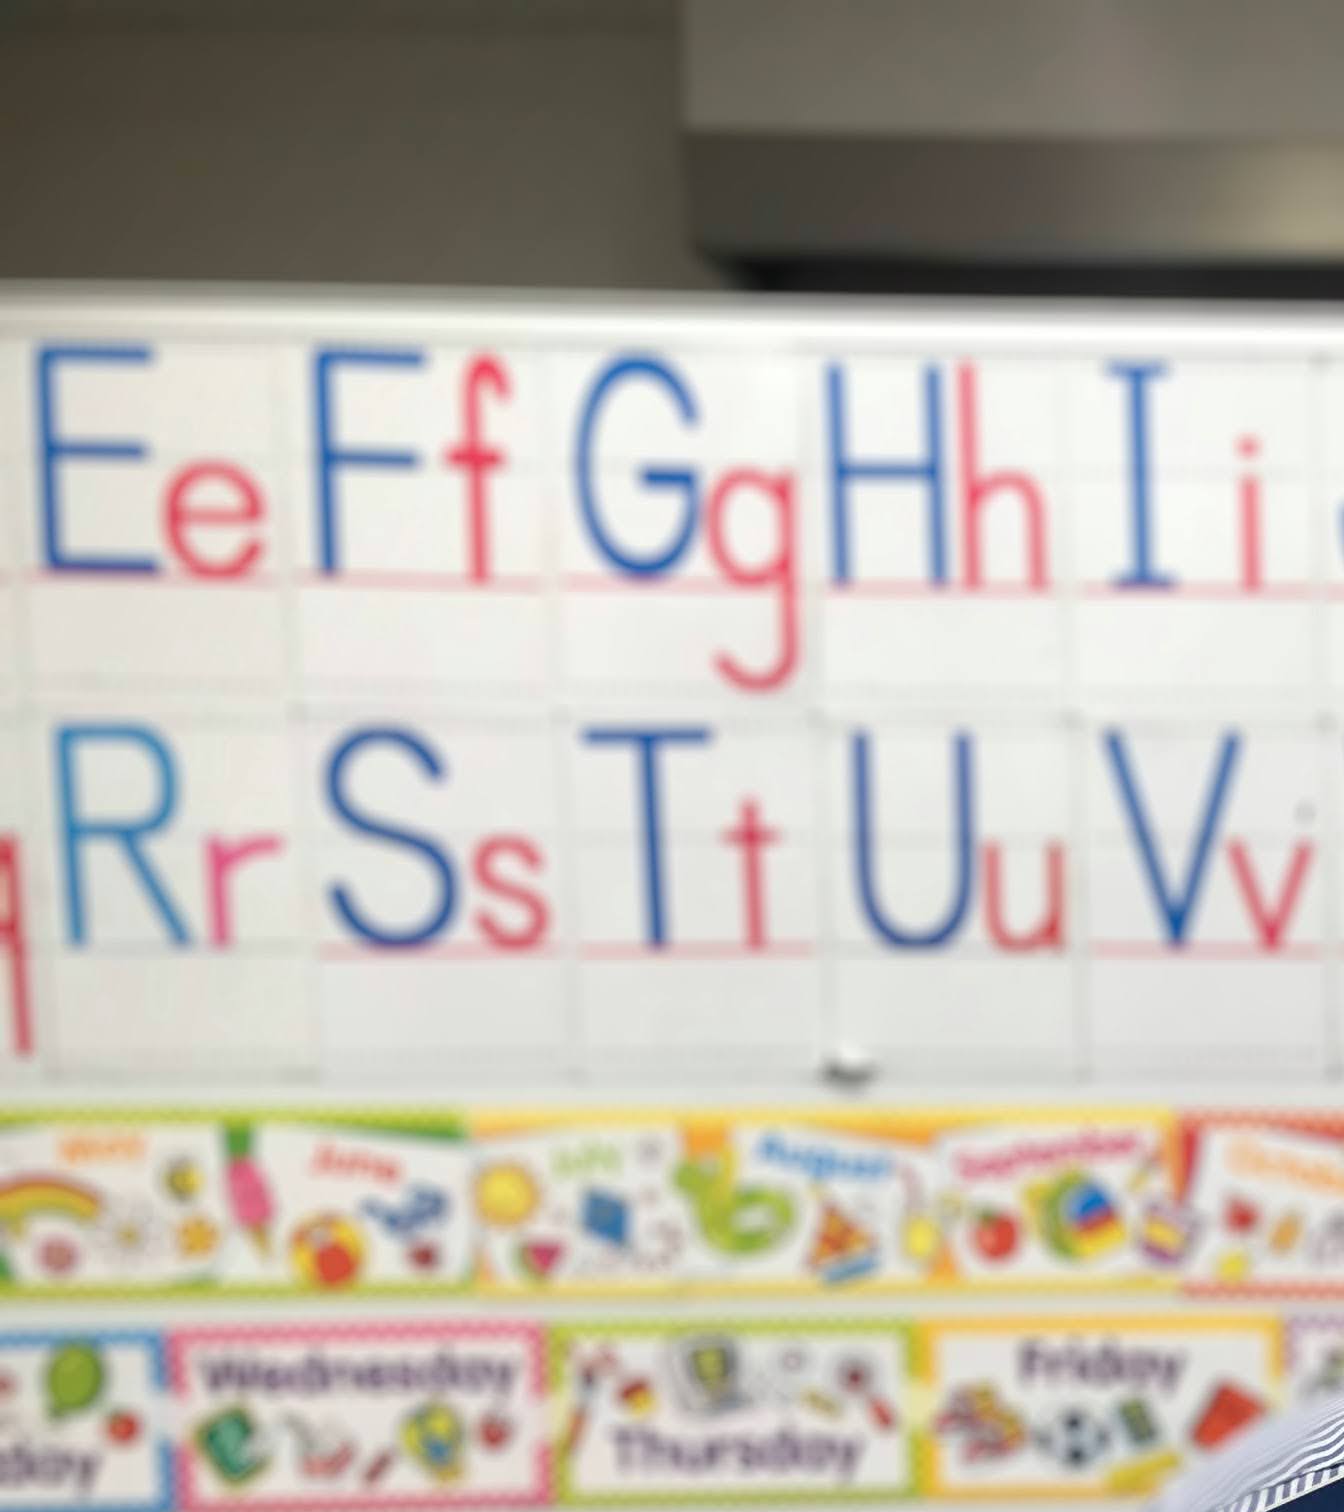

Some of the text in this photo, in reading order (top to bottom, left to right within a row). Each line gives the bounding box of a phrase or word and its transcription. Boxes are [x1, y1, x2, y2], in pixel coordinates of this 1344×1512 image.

[199, 1350, 520, 1401] Wednesday
[1018, 1339, 1186, 1391] Friday
[610, 1425, 865, 1485] Thursday
